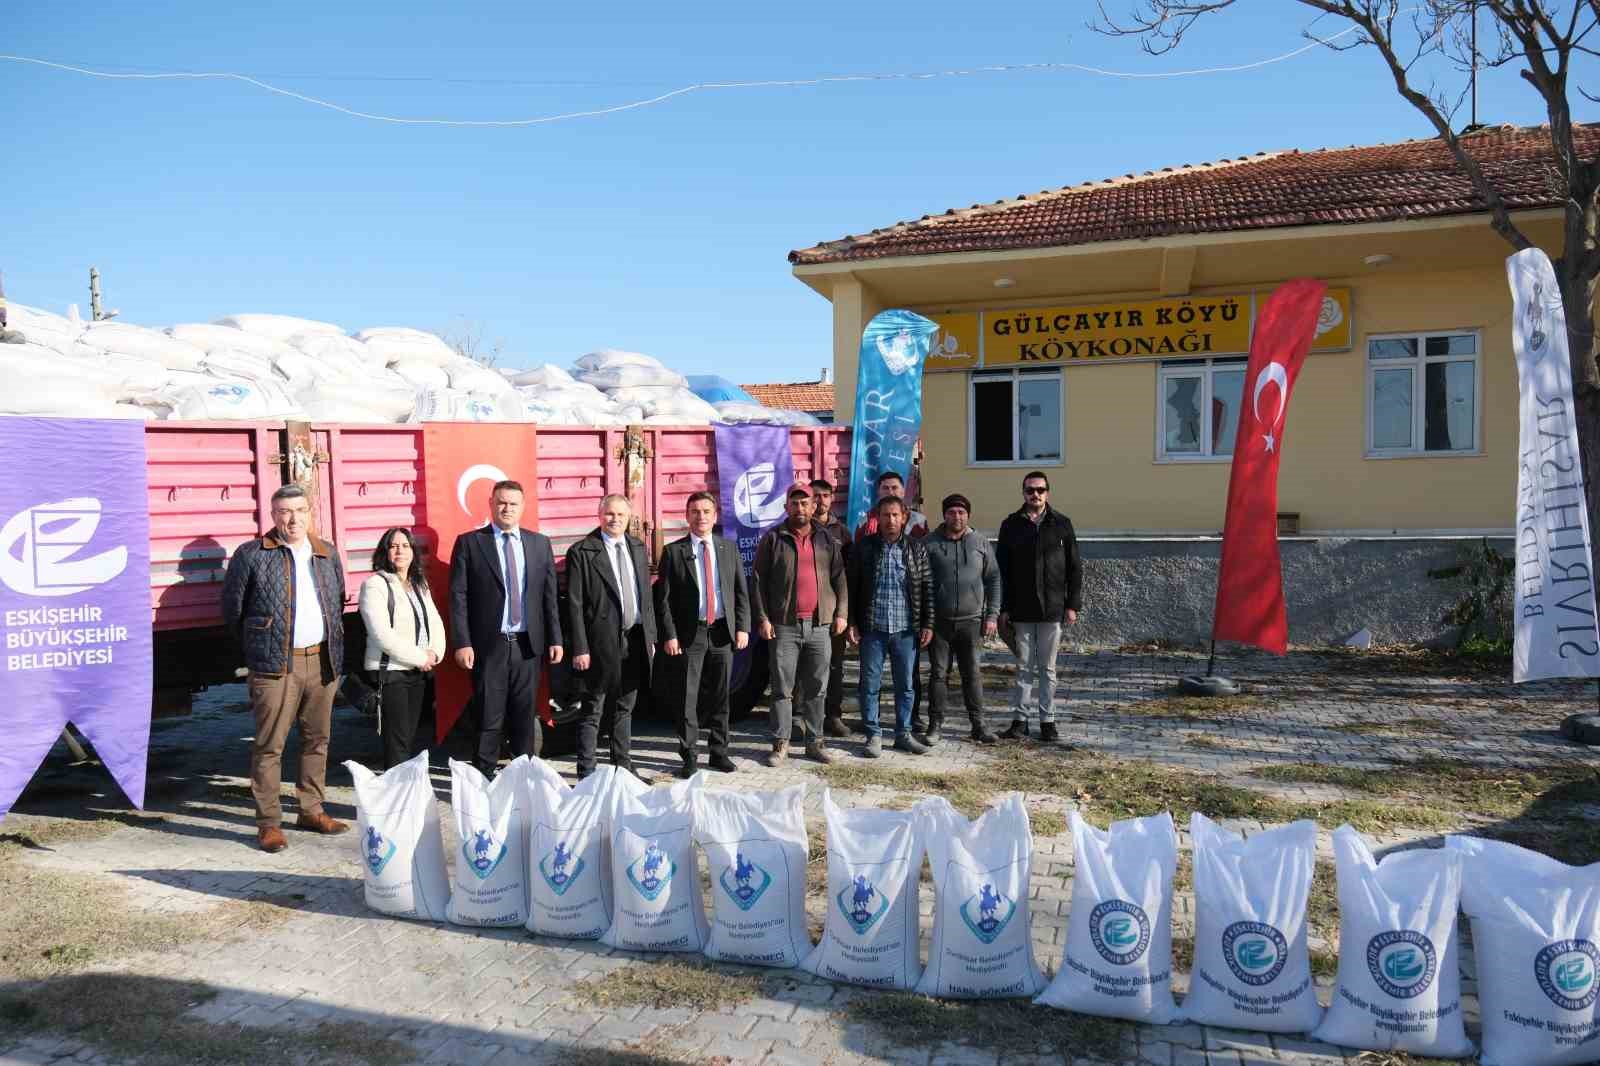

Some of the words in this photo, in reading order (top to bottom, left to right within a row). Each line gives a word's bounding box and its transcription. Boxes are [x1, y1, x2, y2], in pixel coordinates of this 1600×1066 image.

[993, 309, 1145, 336] GÜLÇAYIR
[1155, 299, 1240, 326] KÖYÜ
[1018, 330, 1213, 361] KÖYKONAĞI
[5, 604, 103, 627] ESKİŞEHİR
[6, 624, 128, 649] BÜYÜKŞEHİR
[7, 646, 113, 671] BELEDİYESİ
